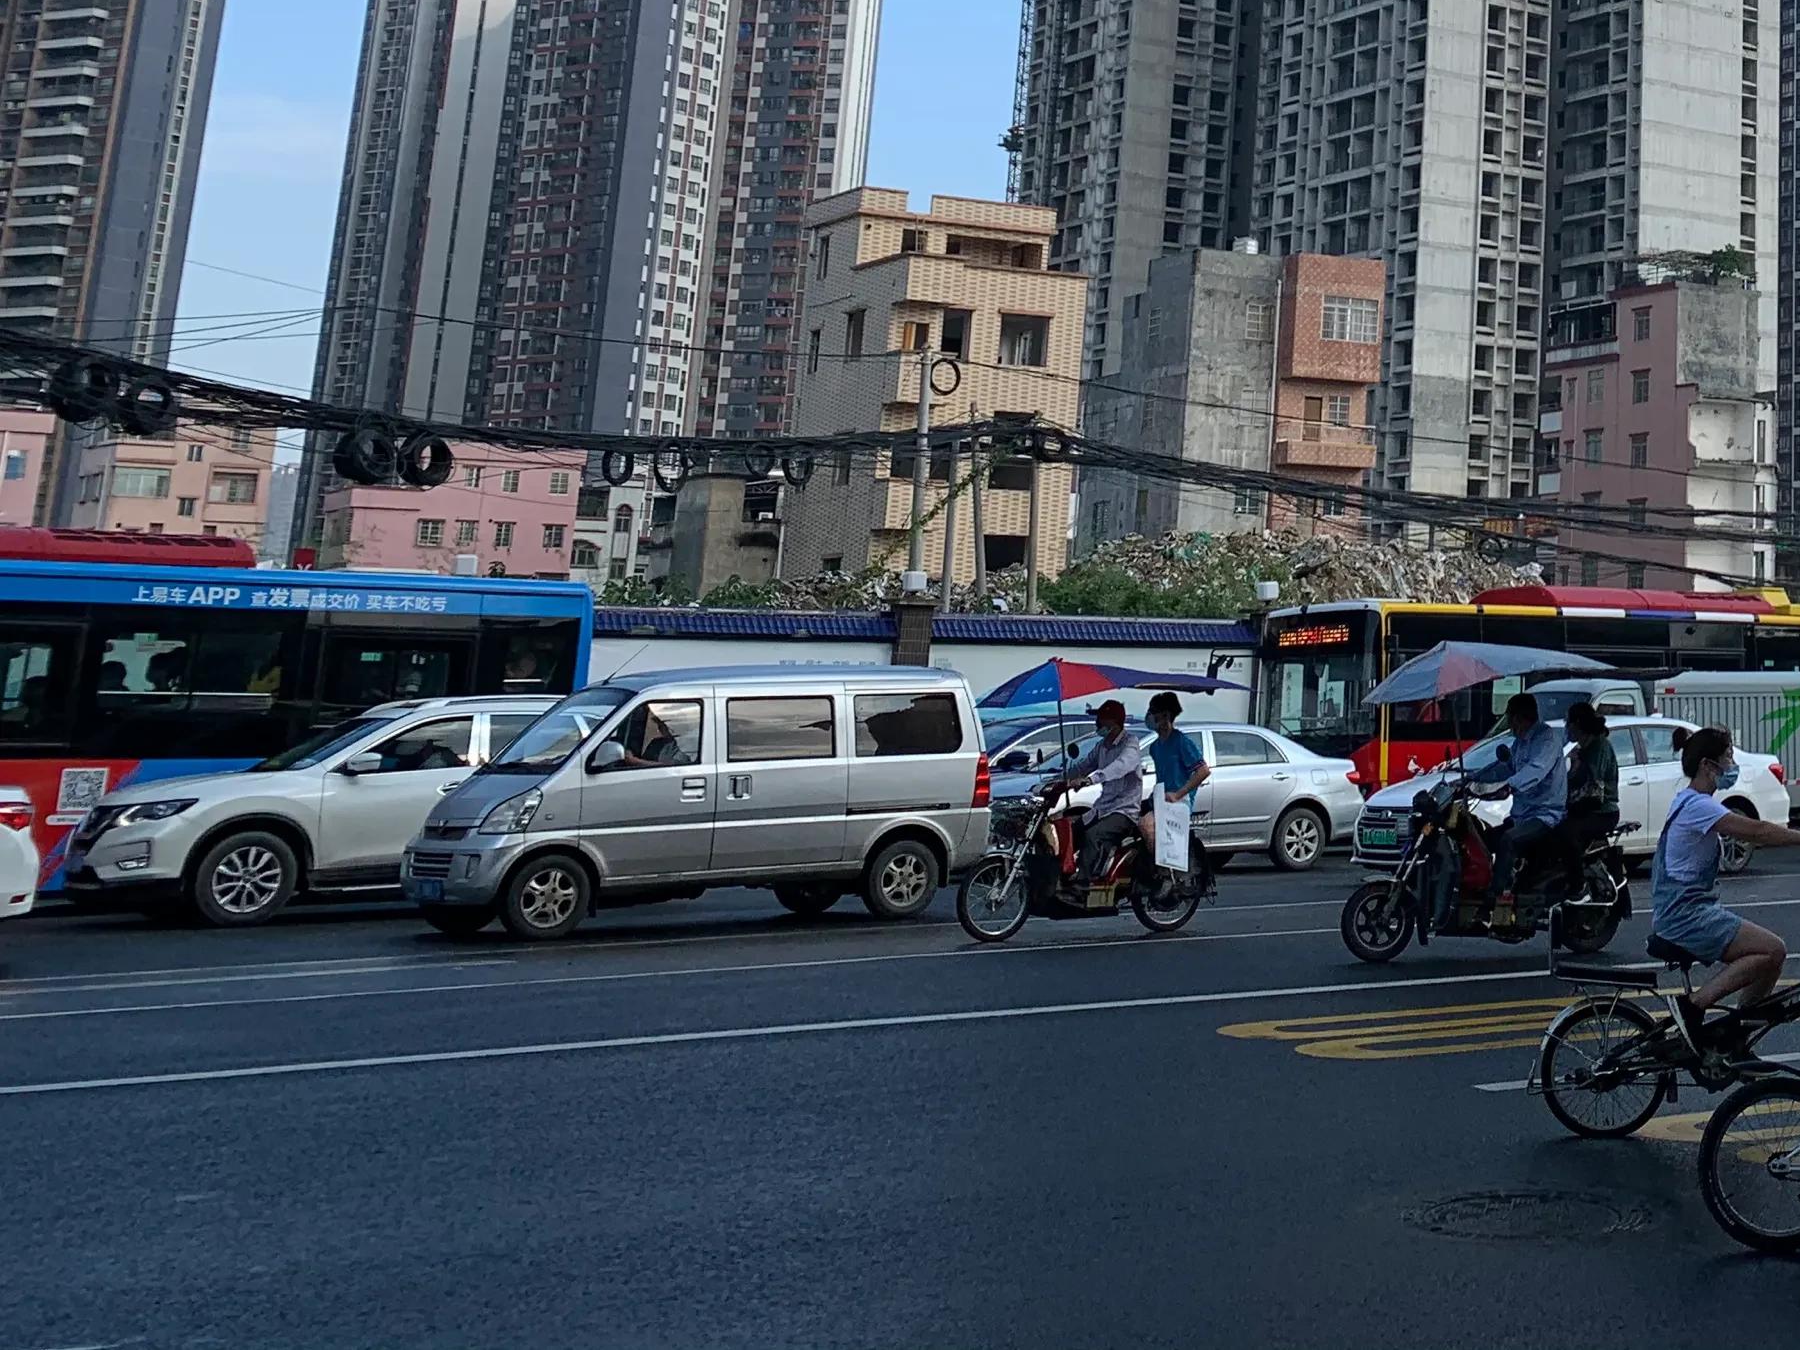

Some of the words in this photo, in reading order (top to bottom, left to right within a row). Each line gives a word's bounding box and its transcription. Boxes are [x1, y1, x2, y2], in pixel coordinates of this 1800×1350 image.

[131, 585, 241, 606] 上易车APP
[250, 587, 360, 610] 查发票成交价
[366, 593, 448, 612] 买车不吃亏
